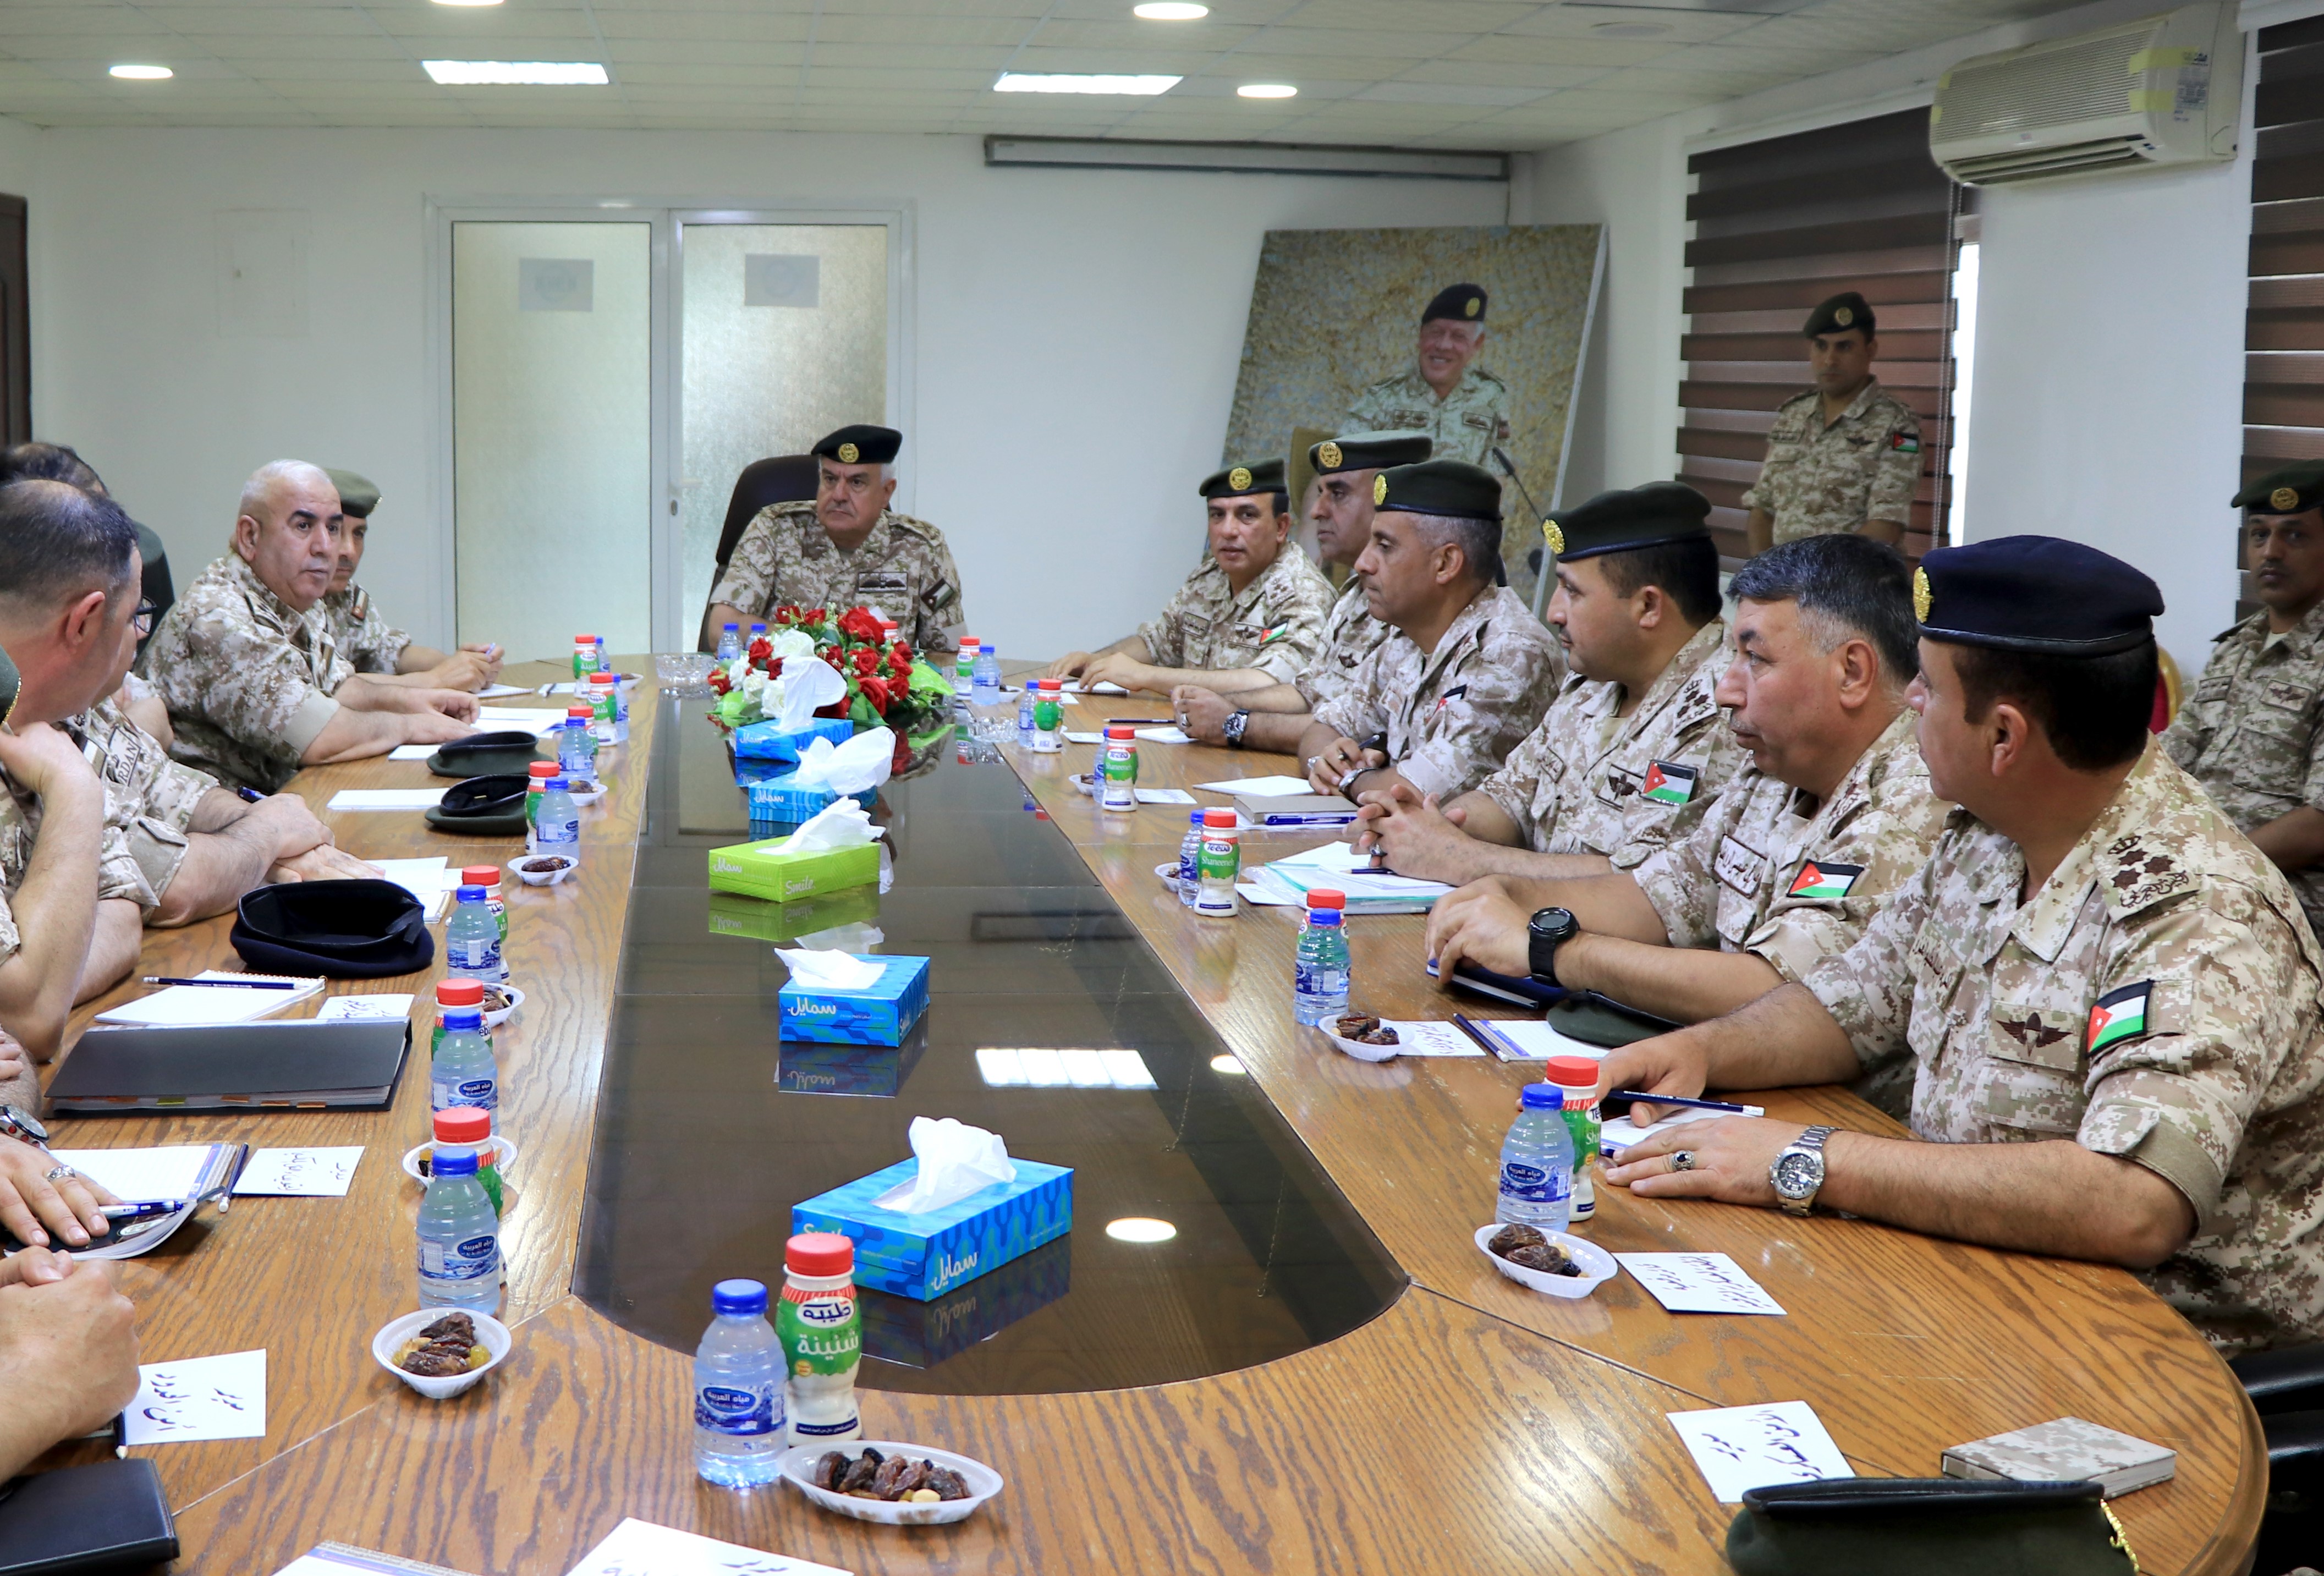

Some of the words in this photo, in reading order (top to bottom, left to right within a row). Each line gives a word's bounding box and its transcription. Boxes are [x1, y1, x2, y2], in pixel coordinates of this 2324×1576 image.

[117, 743, 138, 783] RDAN
[713, 856, 743, 873] سمايل
[785, 876, 814, 895] Smile
[788, 997, 837, 1017] سمايل
[931, 1251, 978, 1292] سمايل
[1695, 1270, 1755, 1291] العسكرية
[1717, 1291, 1772, 1309] الشرقية
[798, 1328, 859, 1360] شنينة
[210, 1387, 244, 1411] مدير
[141, 1406, 197, 1432] أمن
[1745, 1410, 1801, 1437] الأمن
[1701, 1432, 1747, 1463] مدير
